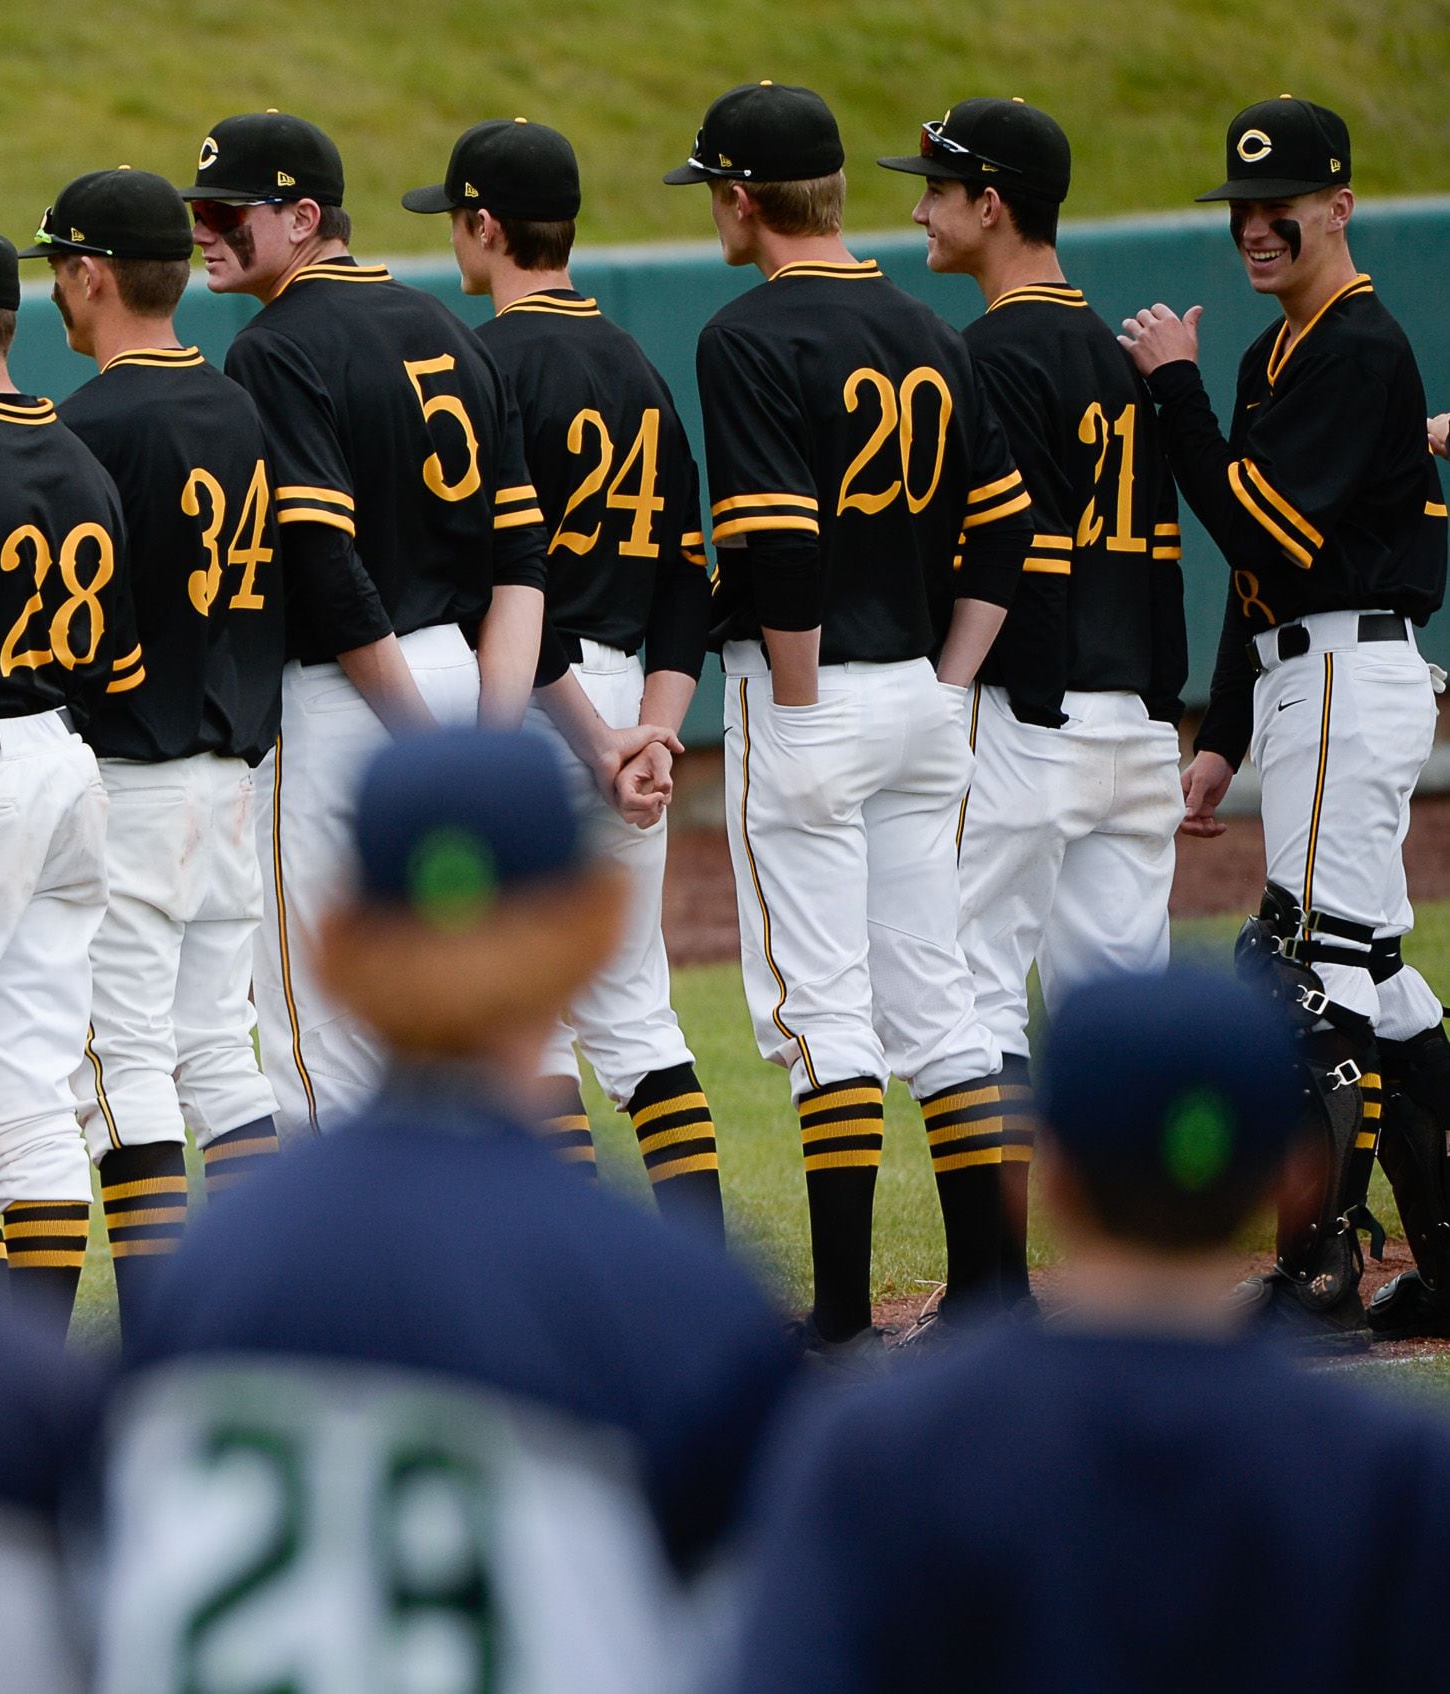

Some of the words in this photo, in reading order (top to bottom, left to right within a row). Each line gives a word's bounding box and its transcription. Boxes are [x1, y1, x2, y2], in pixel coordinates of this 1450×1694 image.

[198, 136, 219, 171] C
[1237, 129, 1272, 162] C
[403, 352, 483, 502] 5
[547, 407, 665, 559] 24
[836, 365, 954, 518] 20
[1075, 400, 1148, 553] 21
[180, 459, 274, 618] 34
